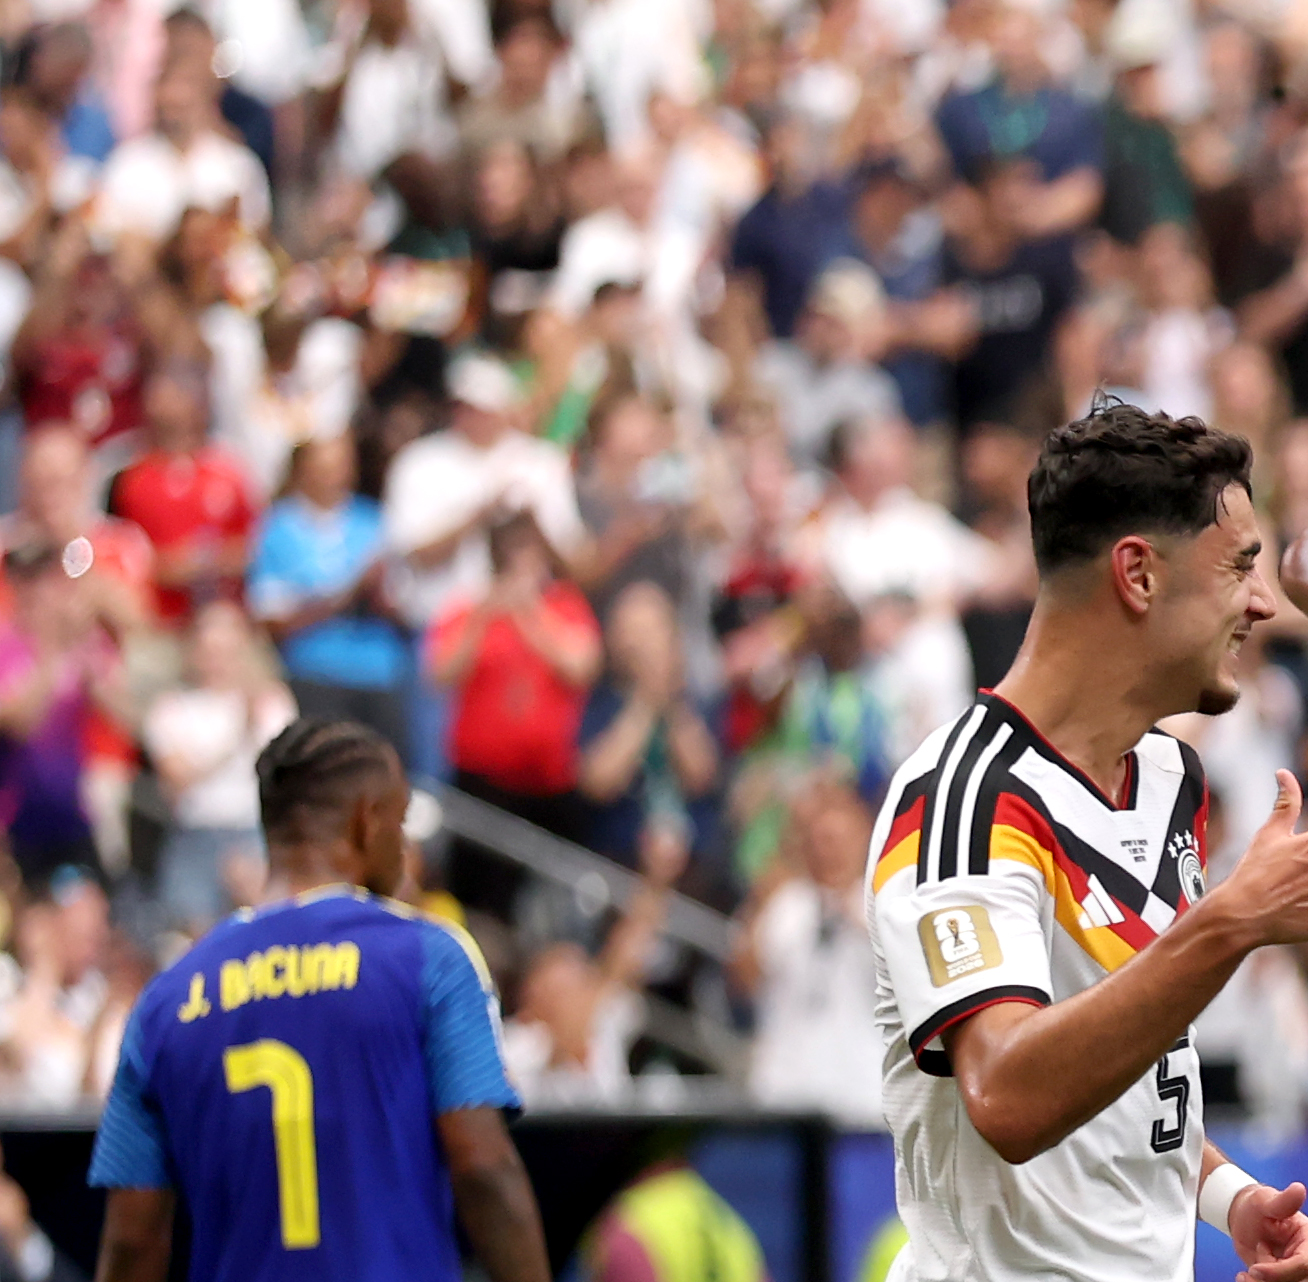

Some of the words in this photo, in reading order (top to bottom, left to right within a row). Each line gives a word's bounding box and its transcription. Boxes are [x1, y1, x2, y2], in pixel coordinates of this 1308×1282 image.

[177, 972, 211, 1023] J.
[220, 941, 360, 1012] BACUNA
[224, 1039, 320, 1248] 7
[1150, 1030, 1190, 1154] 5
